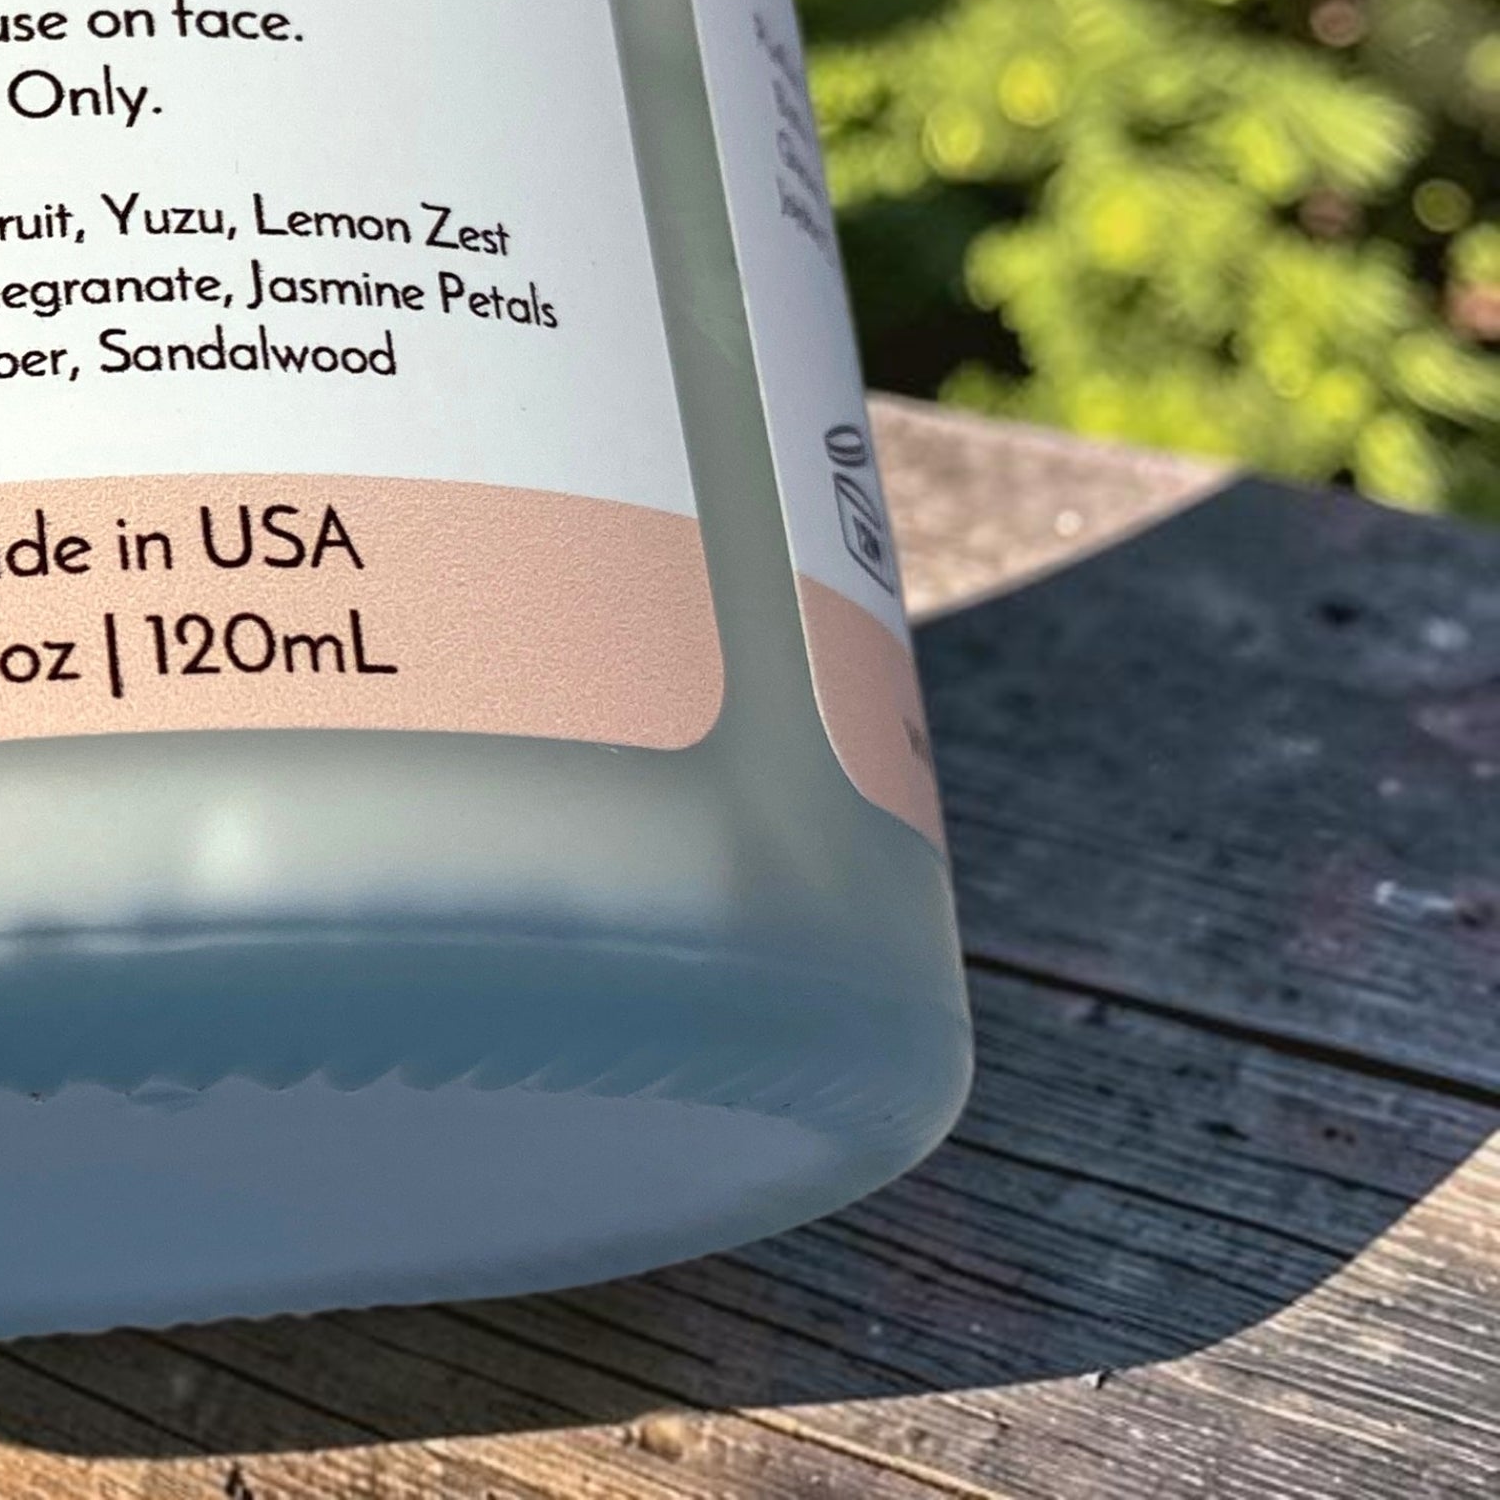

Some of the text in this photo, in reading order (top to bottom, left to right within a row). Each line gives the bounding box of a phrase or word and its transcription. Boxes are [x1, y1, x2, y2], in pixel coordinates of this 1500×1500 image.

[85, 8, 157, 40] on
[6, 62, 164, 129] Only.
[99, 191, 238, 242] Yuzu,
[251, 191, 413, 246] Lemon
[419, 200, 512, 258] Zest
[245, 257, 426, 312] Jasmine
[436, 269, 560, 330] Petals
[97, 322, 398, 377] Sandalwood
[114, 517, 175, 573] in
[198, 502, 367, 572] USA
[143, 607, 400, 677] 120mL
